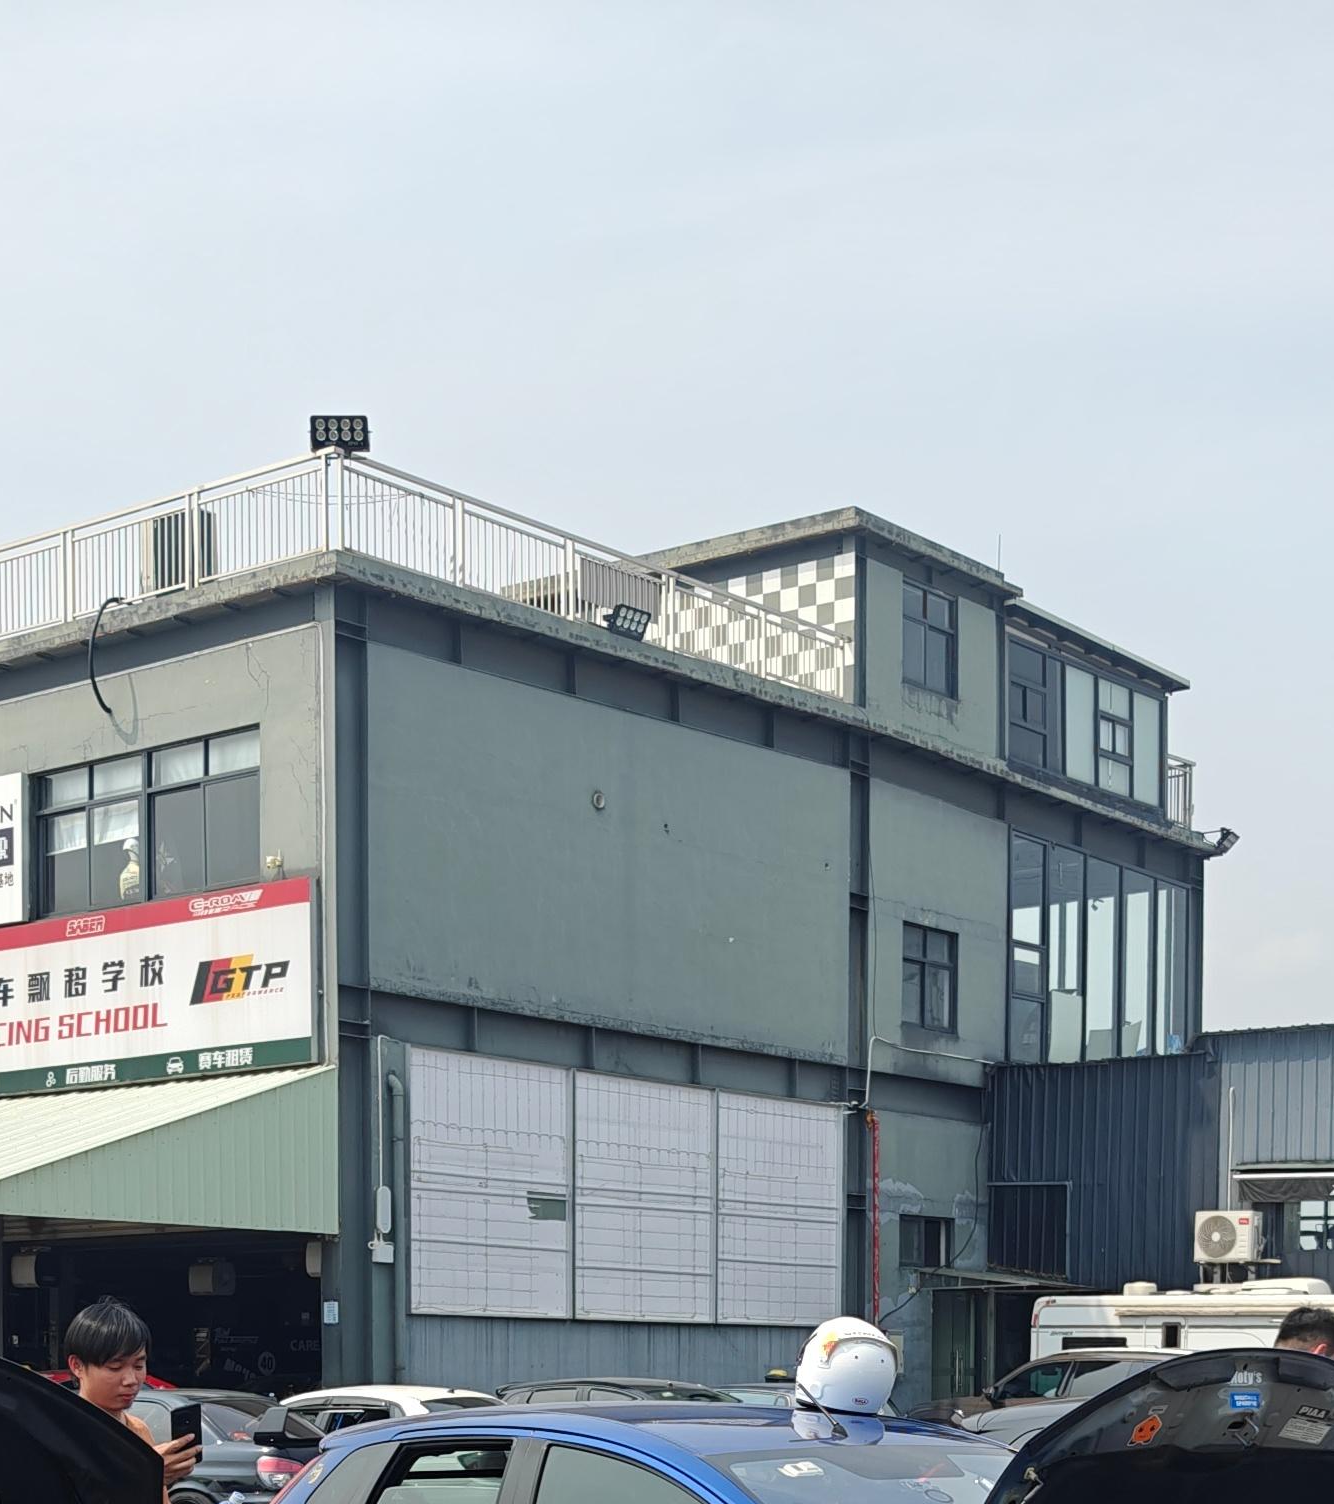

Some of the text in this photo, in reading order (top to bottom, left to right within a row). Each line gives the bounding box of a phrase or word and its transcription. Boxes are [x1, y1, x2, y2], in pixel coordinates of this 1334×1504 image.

[210, 960, 291, 995] GTP
[57, 1002, 169, 1040] SCHOOL
[198, 1047, 254, 1070] 赛车租赁
[65, 1064, 116, 1085] 后勤服务
[1298, 1406, 1327, 1419] PIAA
